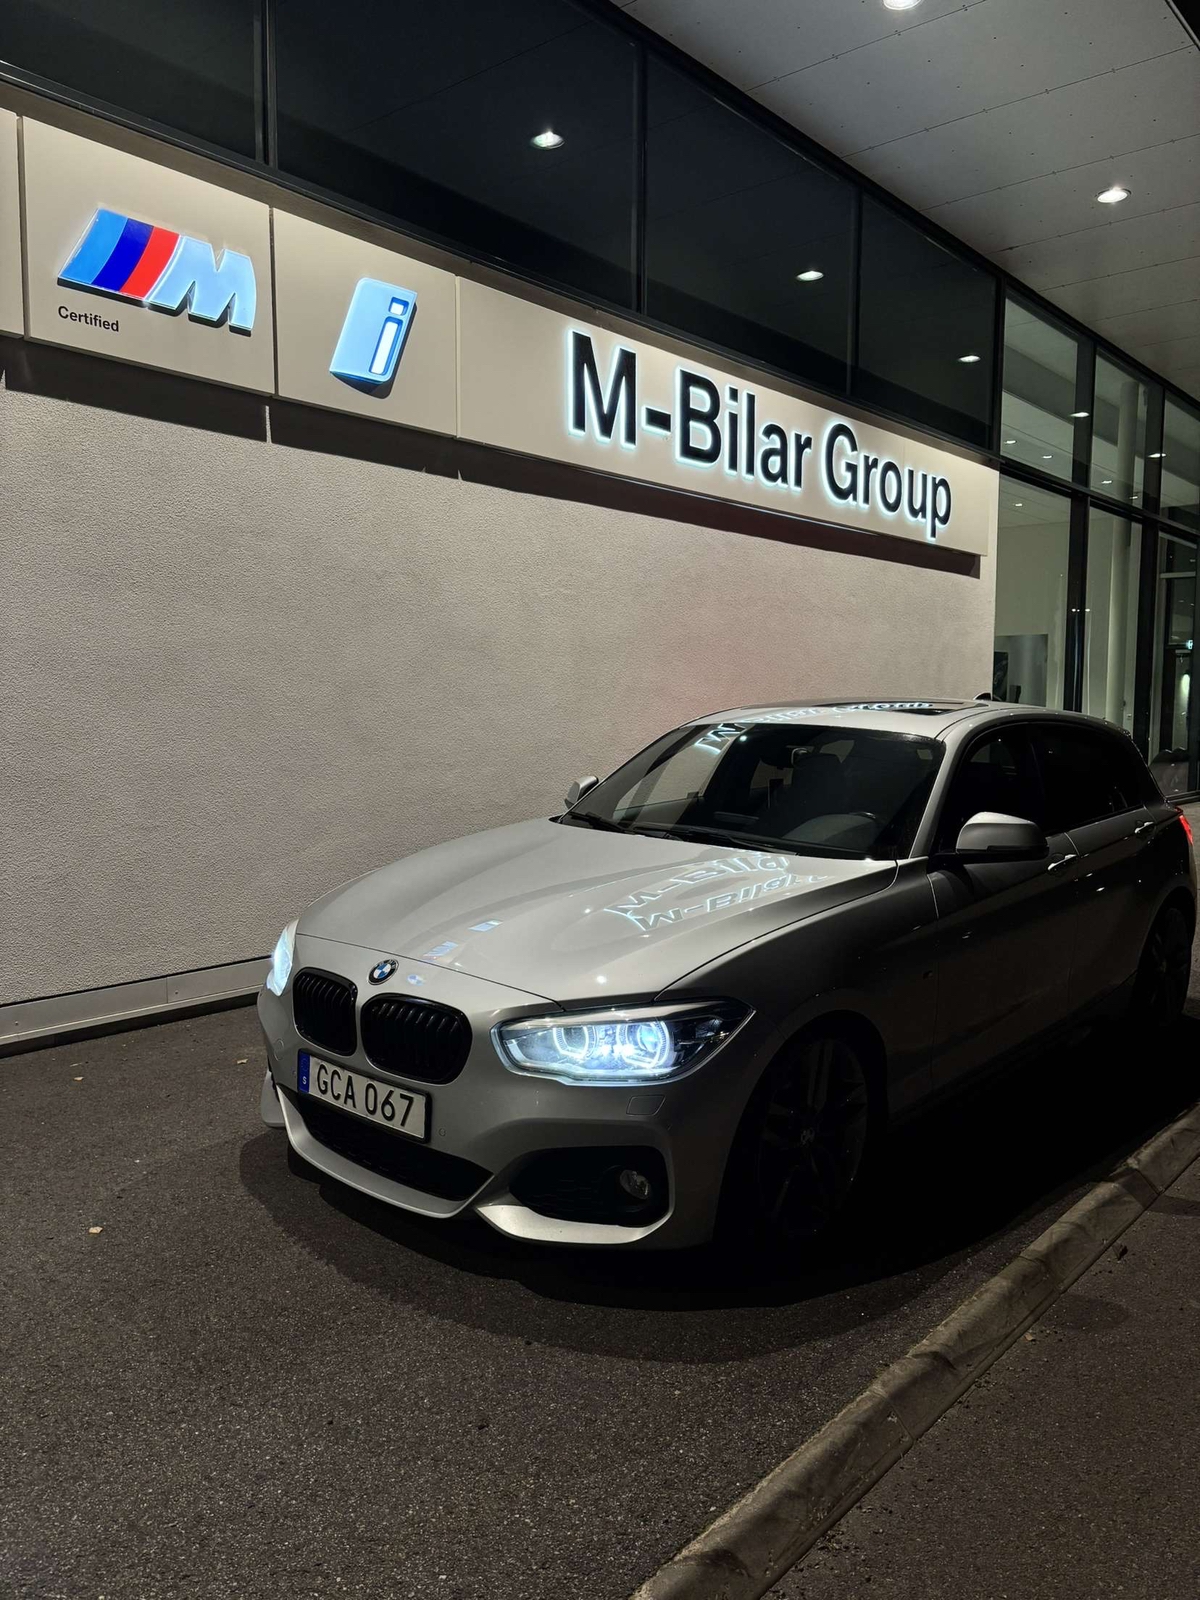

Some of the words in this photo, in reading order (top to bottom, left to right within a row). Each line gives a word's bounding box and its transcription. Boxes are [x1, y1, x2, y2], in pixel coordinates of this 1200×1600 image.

[58, 305, 119, 332] Certified
[570, 330, 812, 490] M-Bilar
[824, 422, 951, 539] Group
[302, 1076, 308, 1085] S
[316, 1063, 357, 1109] GCA
[364, 1082, 415, 1127] 067
